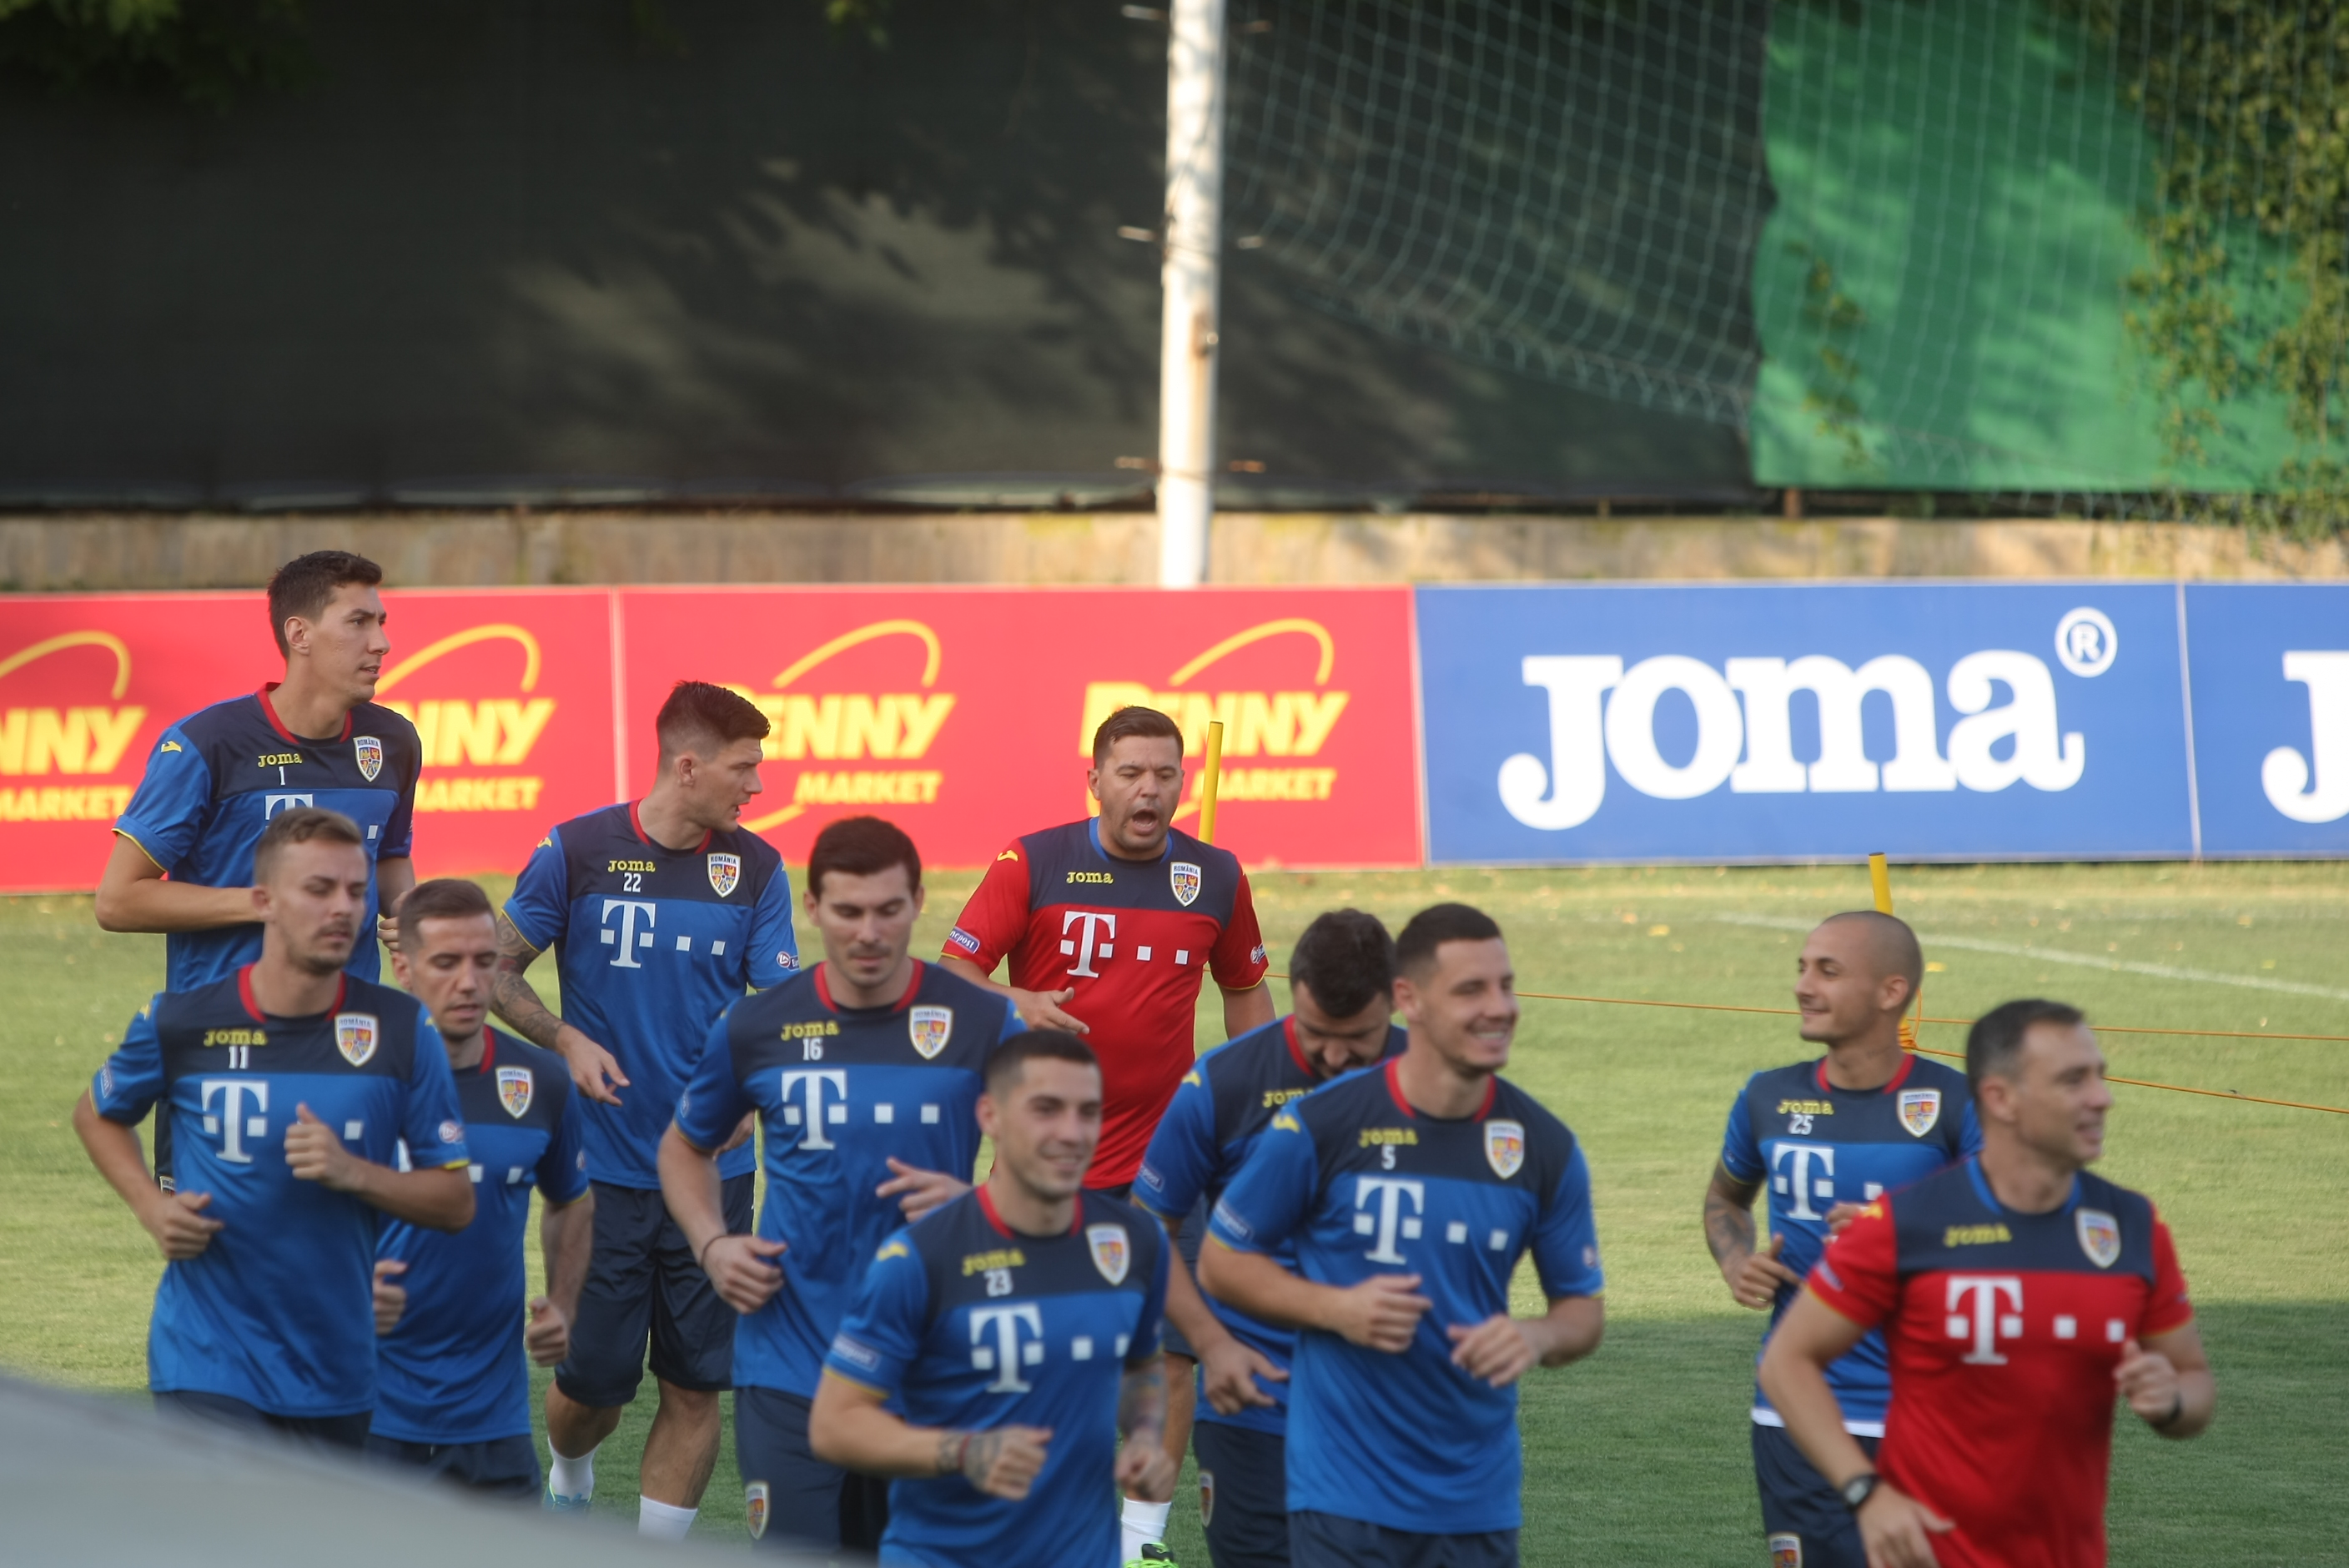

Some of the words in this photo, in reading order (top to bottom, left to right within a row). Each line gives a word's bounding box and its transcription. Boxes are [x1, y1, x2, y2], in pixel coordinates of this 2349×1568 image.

[374, 696, 557, 767] NNY
[711, 682, 956, 761] ENNY
[278, 766, 286, 786] 1
[792, 770, 943, 806] MARKET
[623, 872, 641, 892] 22
[601, 899, 656, 968] T
[1061, 911, 1116, 978] T
[229, 1045, 249, 1069] 11
[802, 1037, 823, 1061] 16
[201, 1079, 269, 1163] T
[781, 1068, 848, 1150] T
[1788, 1114, 1814, 1135] 25
[1381, 1144, 1396, 1170] 5
[1772, 1142, 1834, 1221] T
[1354, 1177, 1425, 1265] T
[984, 1269, 1014, 1297] 23
[968, 1303, 1043, 1393] T
[1944, 1275, 2025, 1364] T
